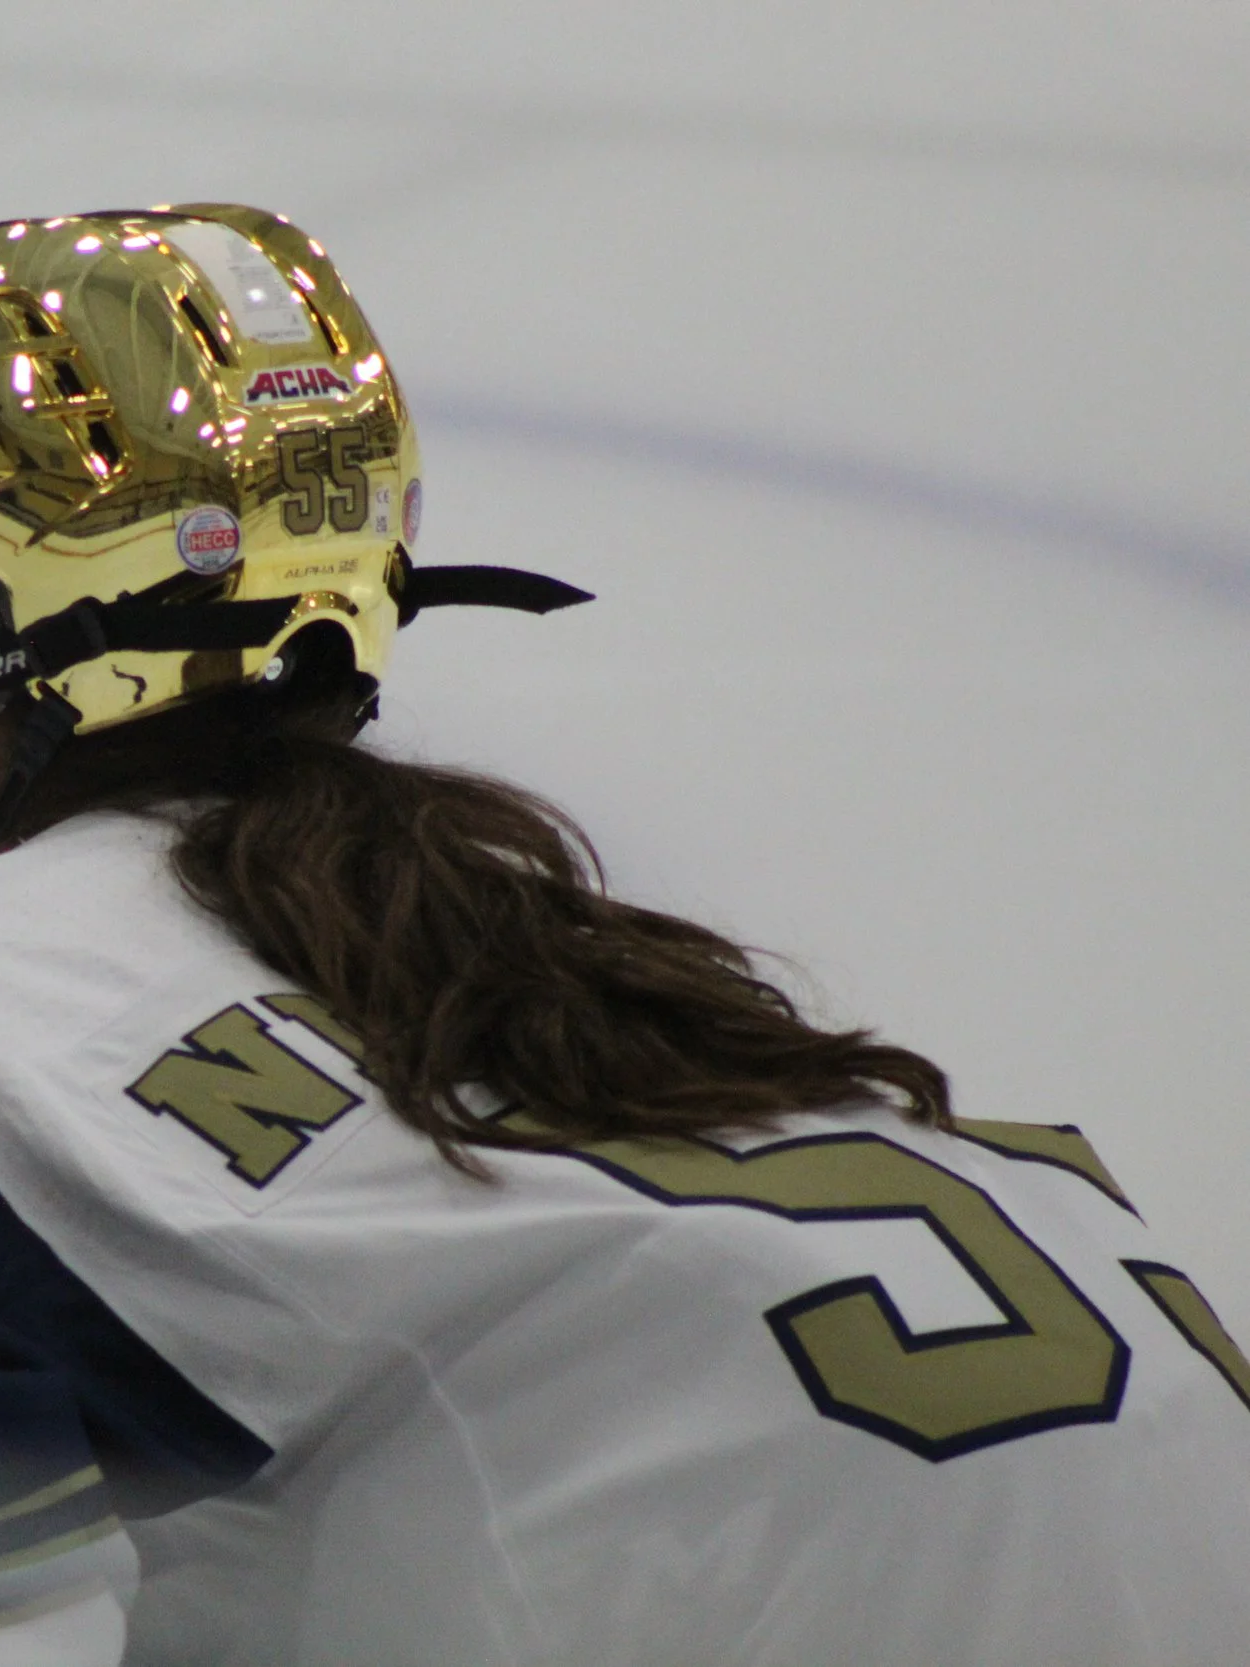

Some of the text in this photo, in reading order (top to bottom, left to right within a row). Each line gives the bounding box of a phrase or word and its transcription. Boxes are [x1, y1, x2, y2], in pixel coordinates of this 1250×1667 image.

[247, 367, 352, 402] ACHA
[276, 426, 369, 536] 55
[191, 531, 236, 550] HECC
